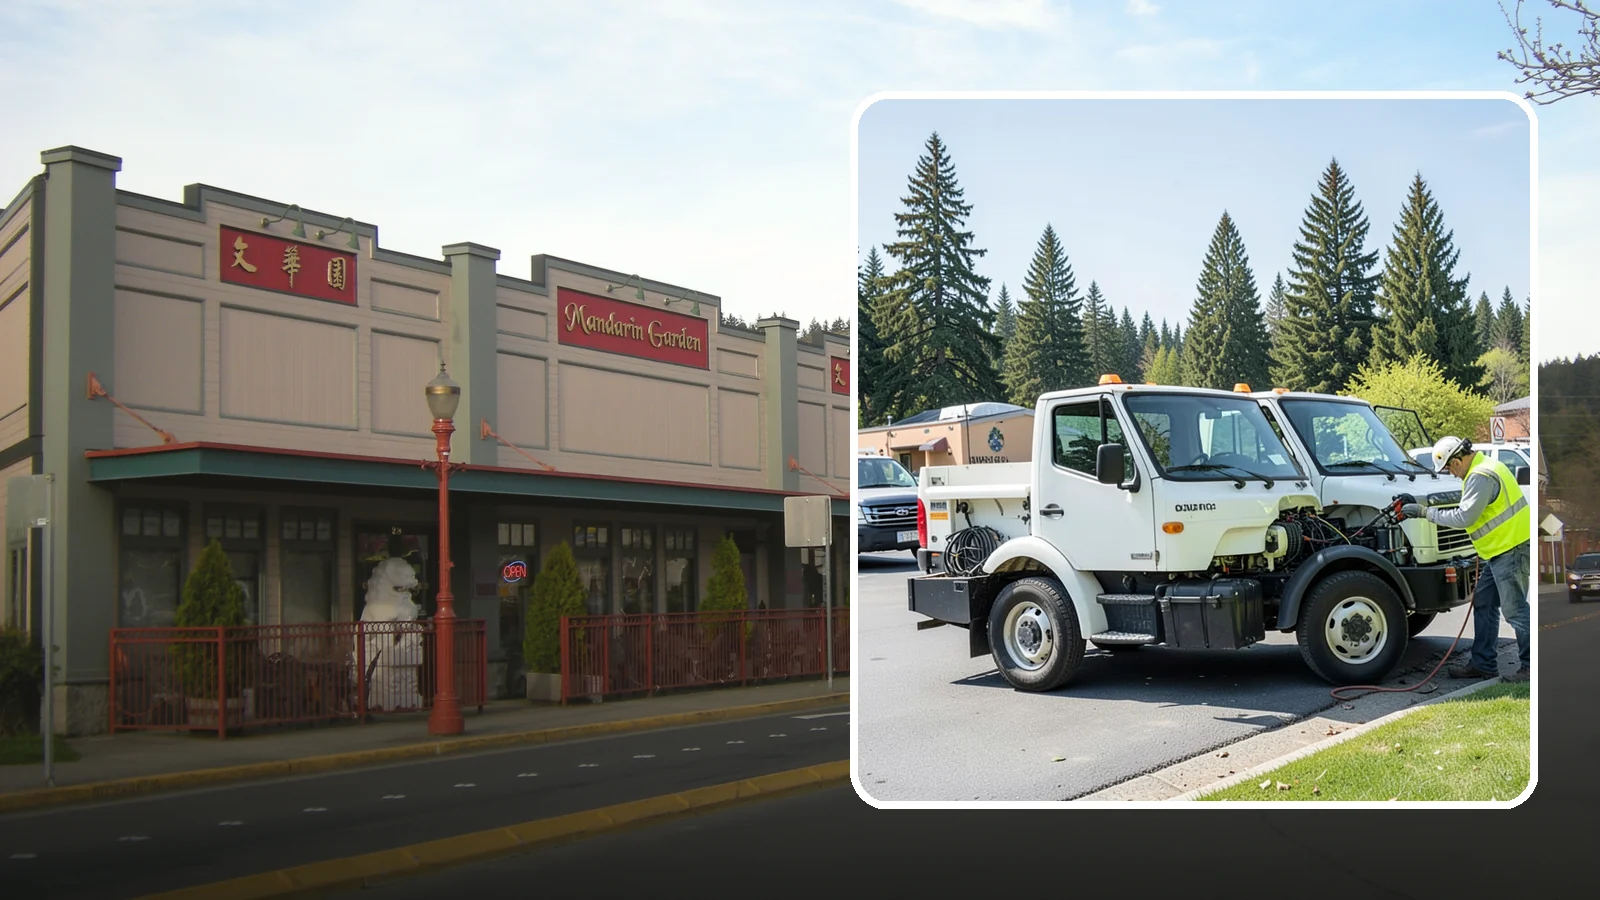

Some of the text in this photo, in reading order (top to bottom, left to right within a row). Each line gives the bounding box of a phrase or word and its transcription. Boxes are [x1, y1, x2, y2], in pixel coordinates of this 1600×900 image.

[230, 235, 347, 291] 文華園
[564, 302, 702, 352] Mandarin Garden
[503, 565, 527, 578] OPEN
